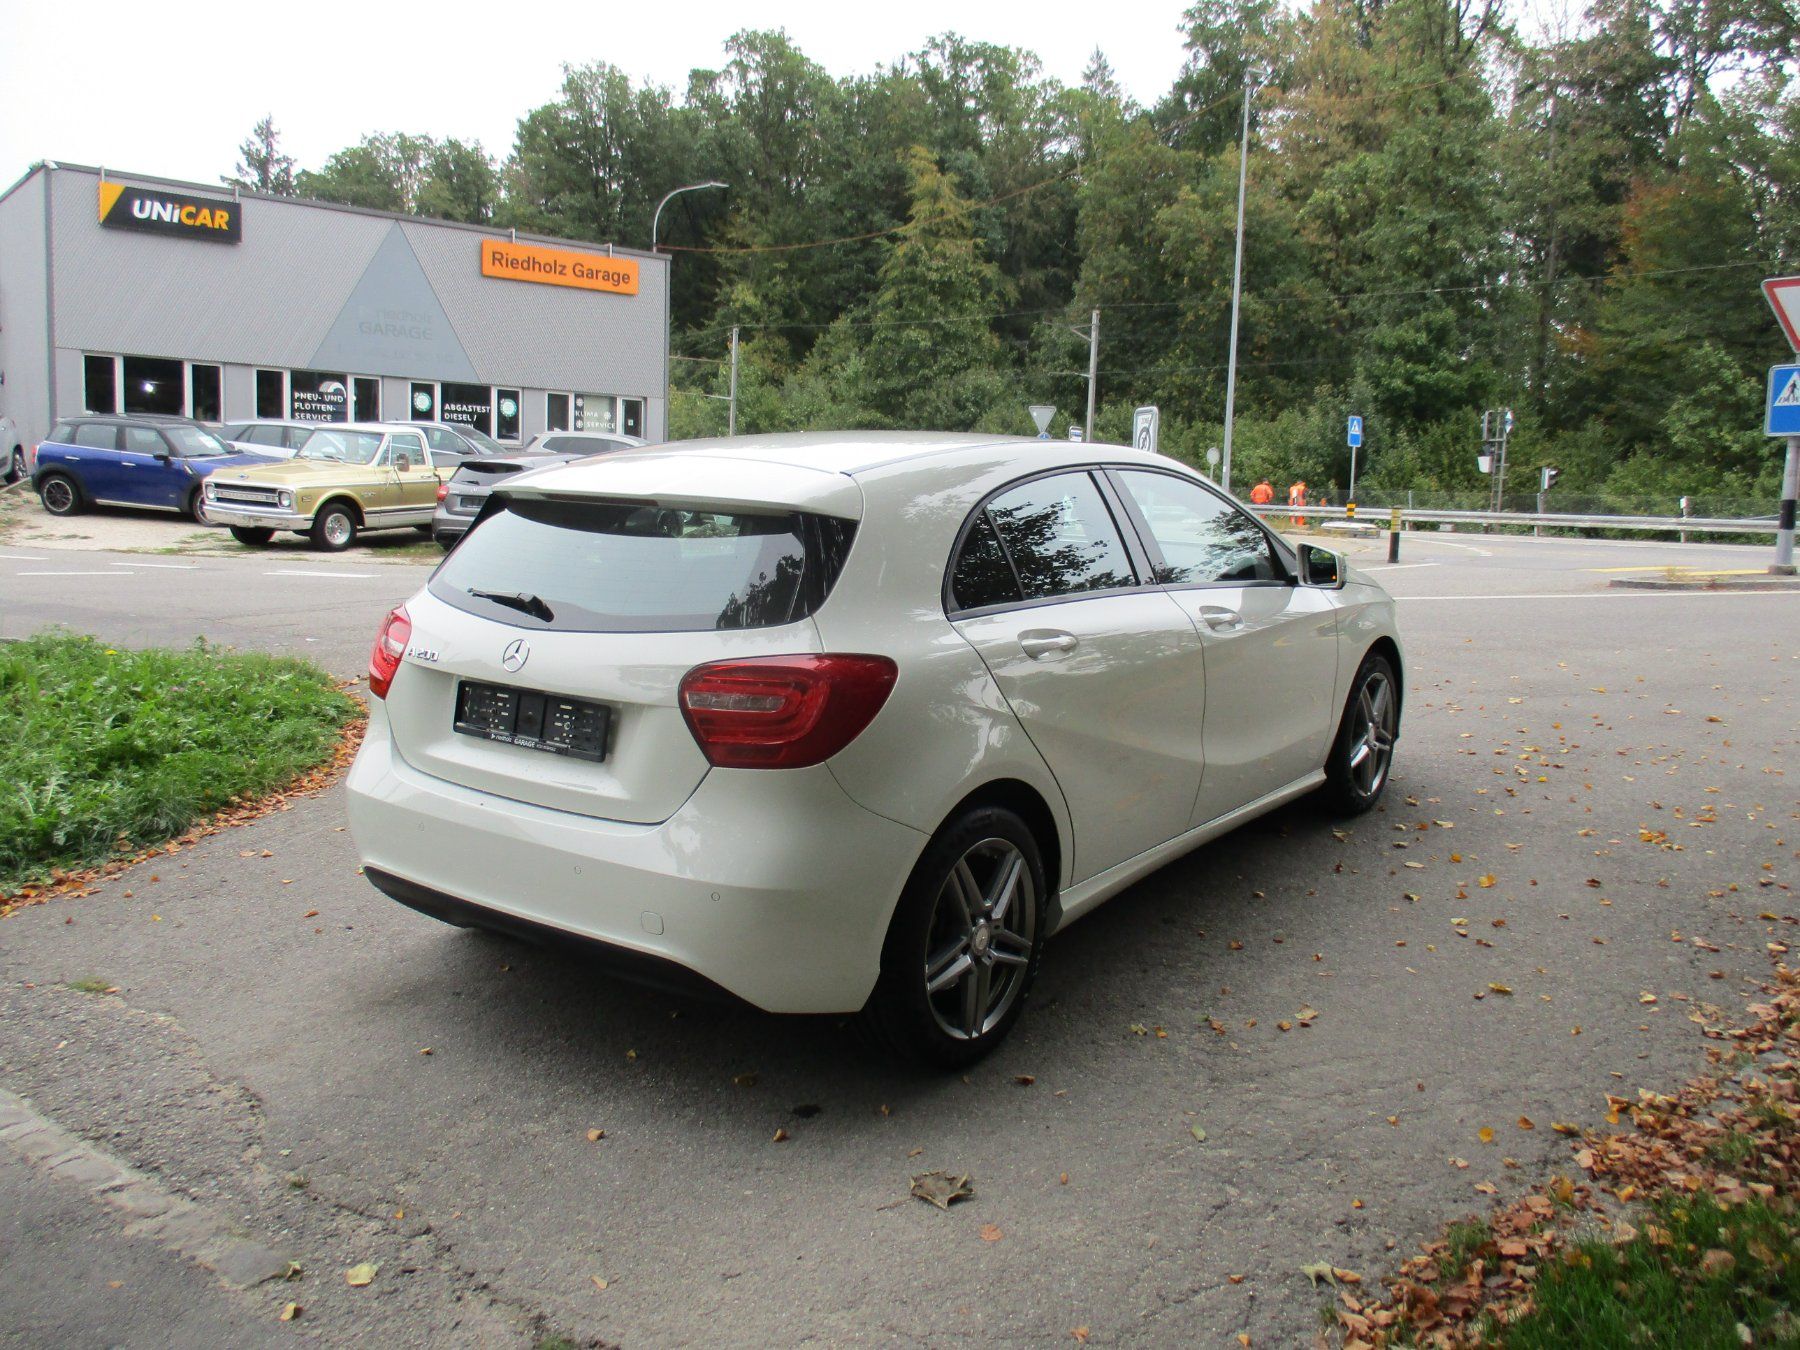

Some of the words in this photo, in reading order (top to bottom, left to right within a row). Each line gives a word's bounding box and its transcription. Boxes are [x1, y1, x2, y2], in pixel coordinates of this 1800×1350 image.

[491, 250, 567, 277] Riedholz
[572, 262, 631, 287] Garage
[358, 321, 433, 341] GARAGE
[294, 391, 322, 401] PNEU-
[324, 394, 344, 403] UND
[294, 402, 336, 412] FLOTTEN-
[444, 403, 491, 413] ABGASTEST
[294, 412, 332, 422] SERVICE
[444, 413, 472, 422] DIESEL
[575, 410, 599, 418] KLIMA
[586, 421, 615, 429] SERVICE
[514, 738, 535, 748] GARAGE
